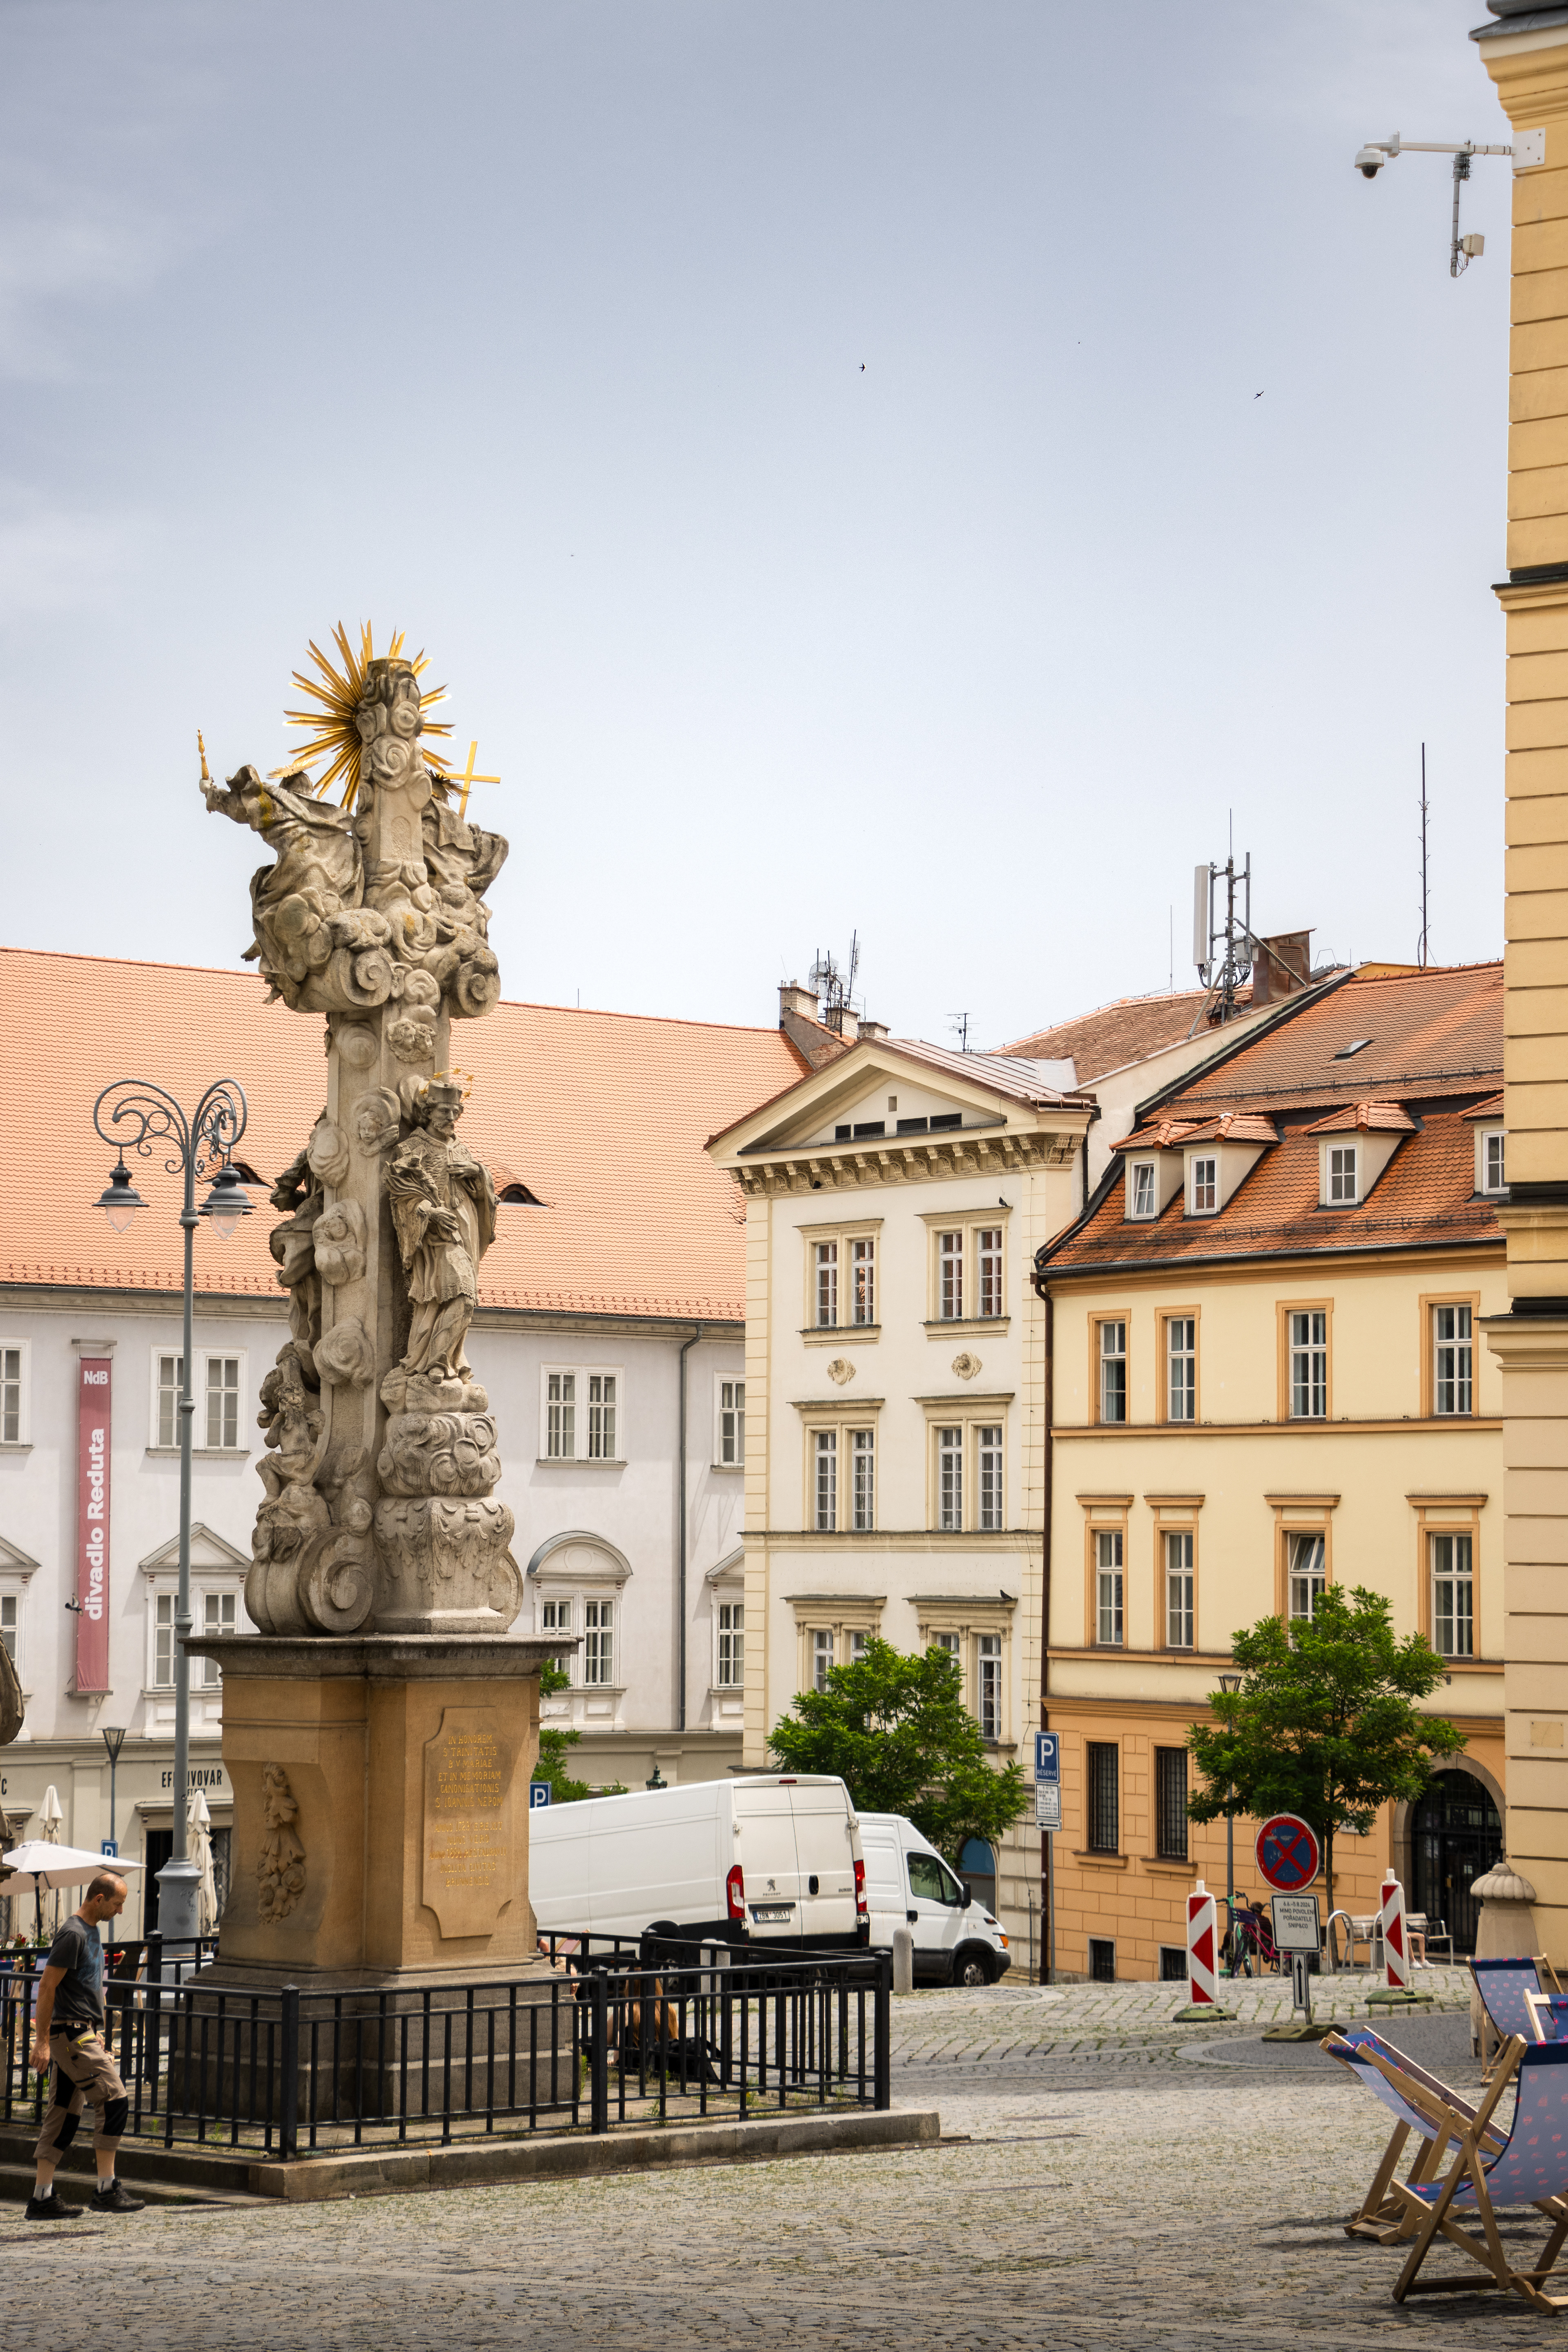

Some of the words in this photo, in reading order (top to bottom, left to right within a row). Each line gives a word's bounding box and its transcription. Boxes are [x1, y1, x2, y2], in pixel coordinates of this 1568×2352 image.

[84, 1371, 108, 1385] NdB
[87, 1428, 105, 1519] Reduta
[85, 1527, 104, 1620] divadlo
[448, 1735, 456, 1744] IN
[459, 1735, 492, 1744] HONOREM
[443, 1748, 448, 1756] S
[451, 1746, 497, 1756] TRINITATIS
[1041, 1739, 1054, 1766] P
[448, 1760, 453, 1768] B
[463, 1759, 492, 1768] MARIAE
[187, 1769, 222, 1787] IVOVAR
[439, 1773, 448, 1781] ET
[450, 1772, 457, 1781] IN
[460, 1771, 501, 1780] MEMORIAM
[440, 1784, 499, 1793] CANONISATIONIS
[435, 1797, 440, 1808] S
[477, 1797, 503, 1806] NEPOM
[534, 1788, 546, 1808] P
[474, 1822, 503, 1831] EREXIT
